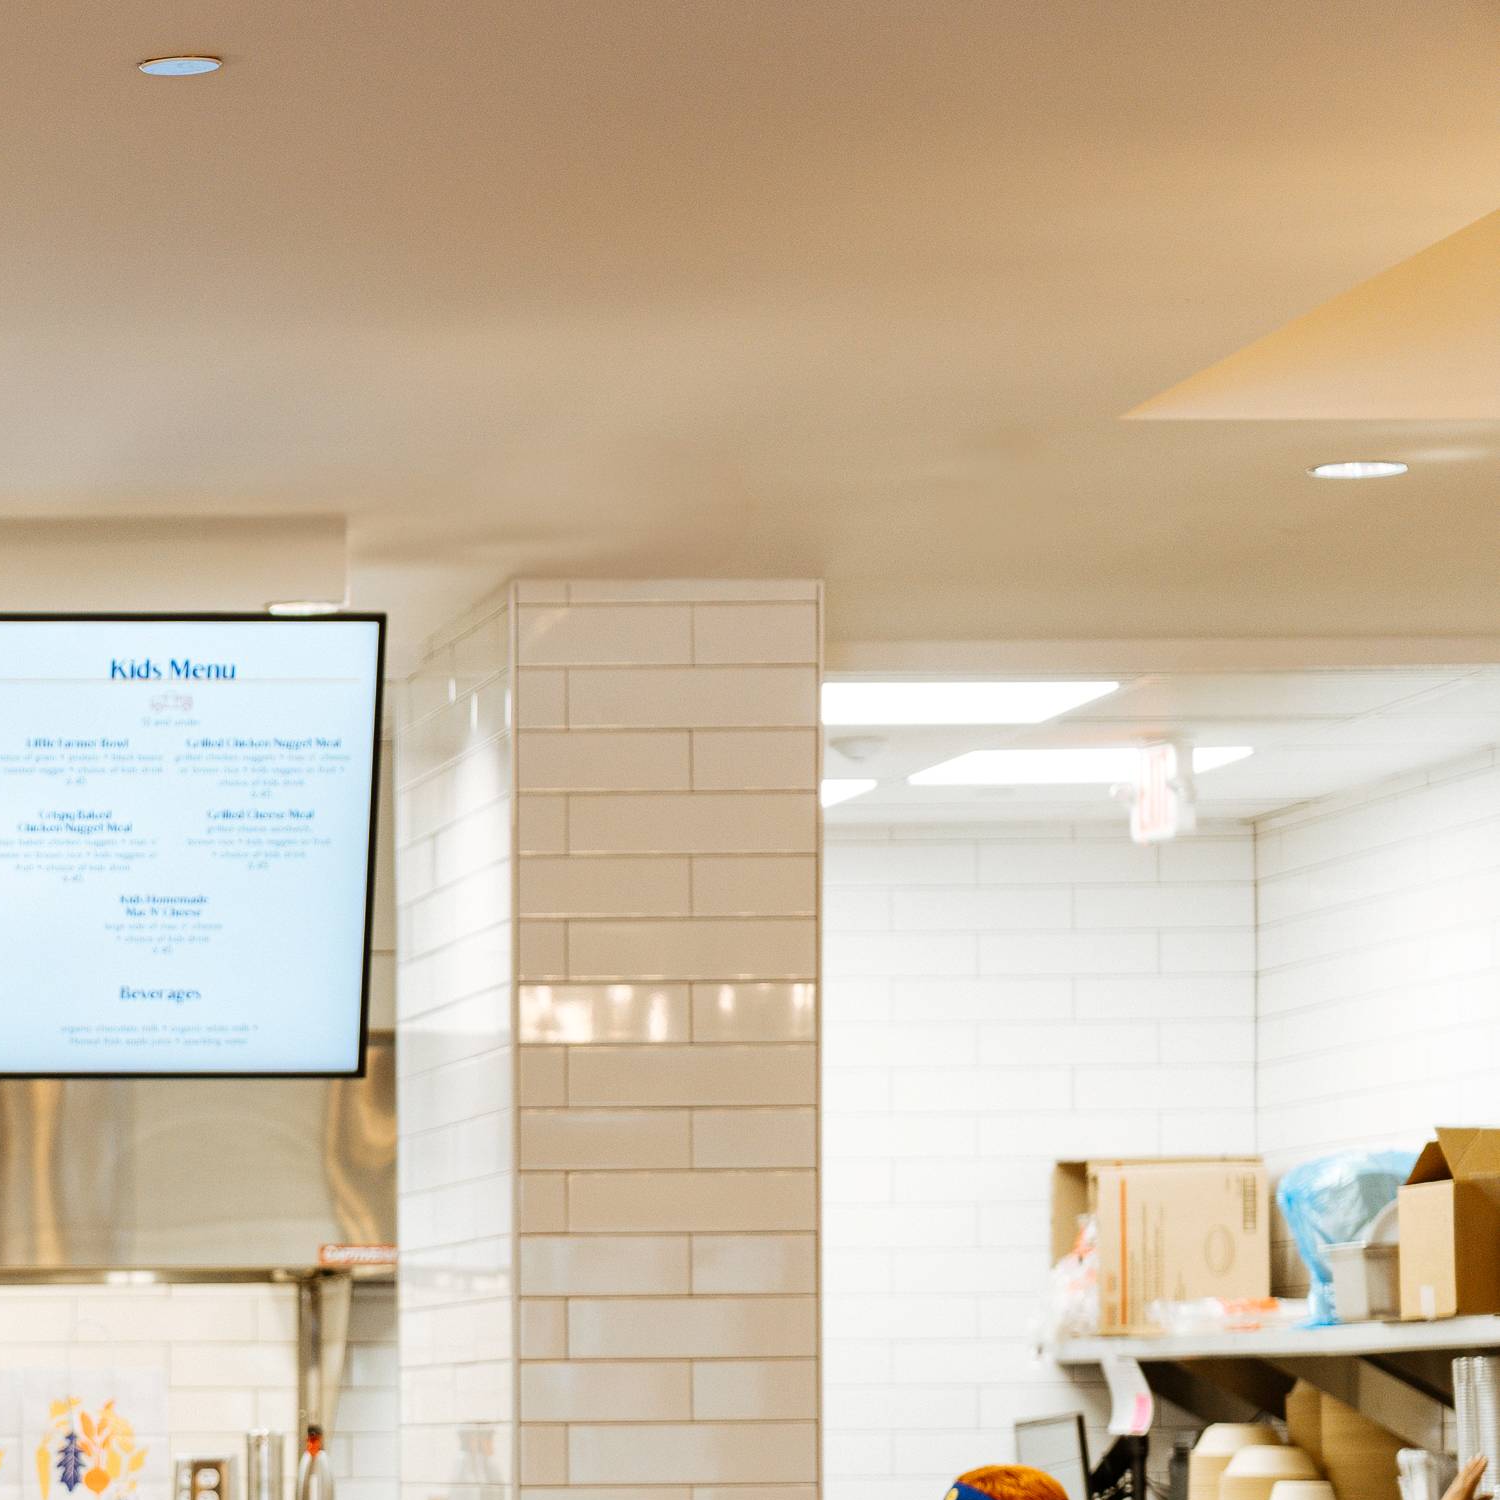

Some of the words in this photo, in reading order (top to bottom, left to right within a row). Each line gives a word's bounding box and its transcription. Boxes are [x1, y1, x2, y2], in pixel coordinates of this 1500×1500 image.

[110, 658, 161, 680] Kids
[168, 658, 236, 680] Menu
[120, 987, 201, 1003] Beverages
